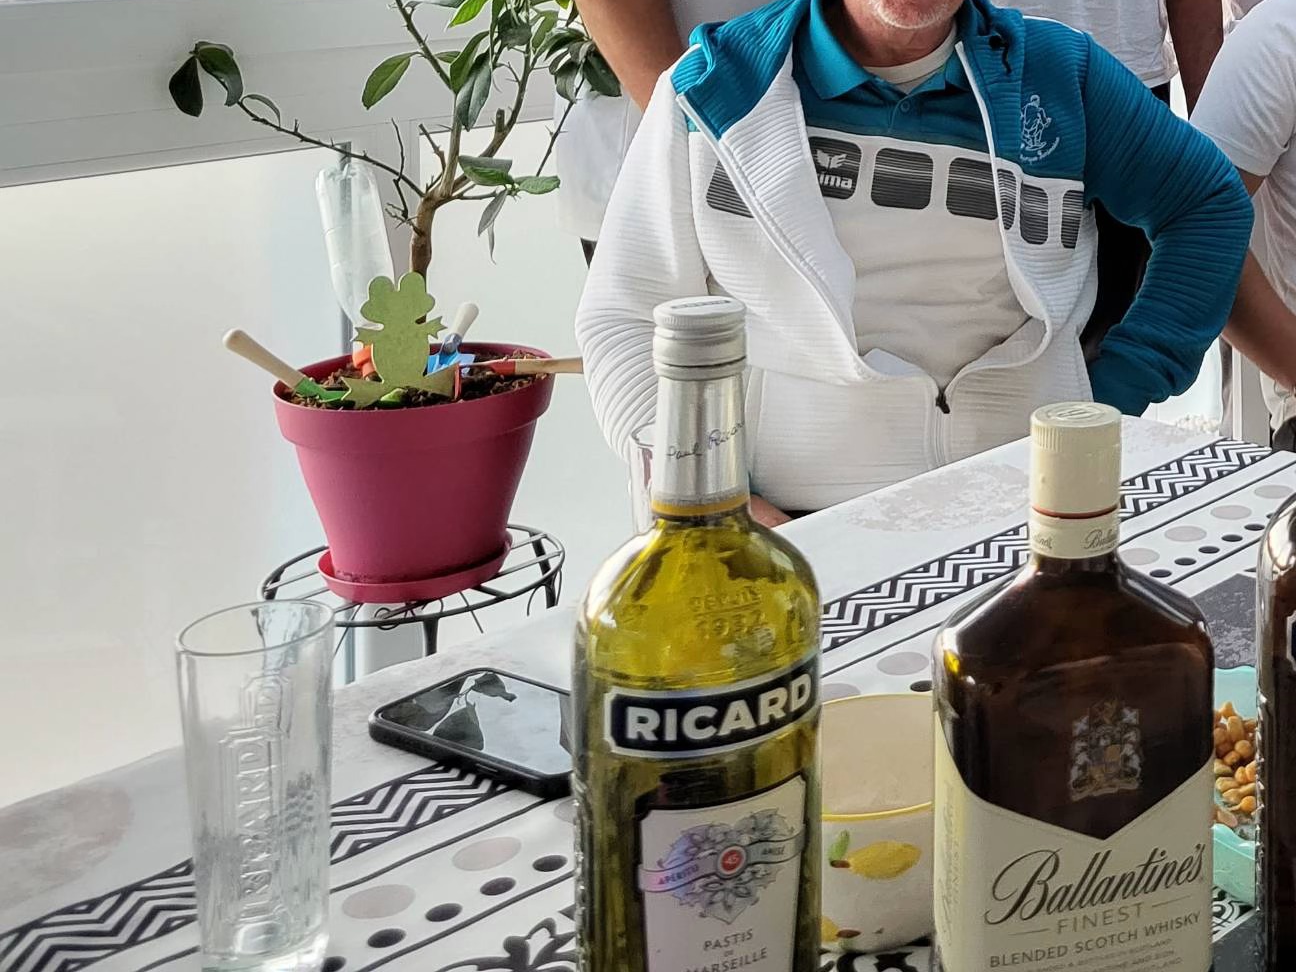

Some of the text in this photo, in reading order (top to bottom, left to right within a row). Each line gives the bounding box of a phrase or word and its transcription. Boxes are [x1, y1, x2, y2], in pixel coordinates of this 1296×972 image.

[817, 171, 853, 189] ima
[625, 673, 812, 742] RICARD
[984, 843, 1206, 925] Ballantine's
[1056, 902, 1145, 934] FINEST
[703, 928, 754, 951] PASTIS
[989, 944, 1069, 968] BLENDED
[1074, 930, 1138, 955] SCOTCH
[1144, 910, 1201, 938] WHISKY
[686, 947, 768, 972] ARSEILLE
